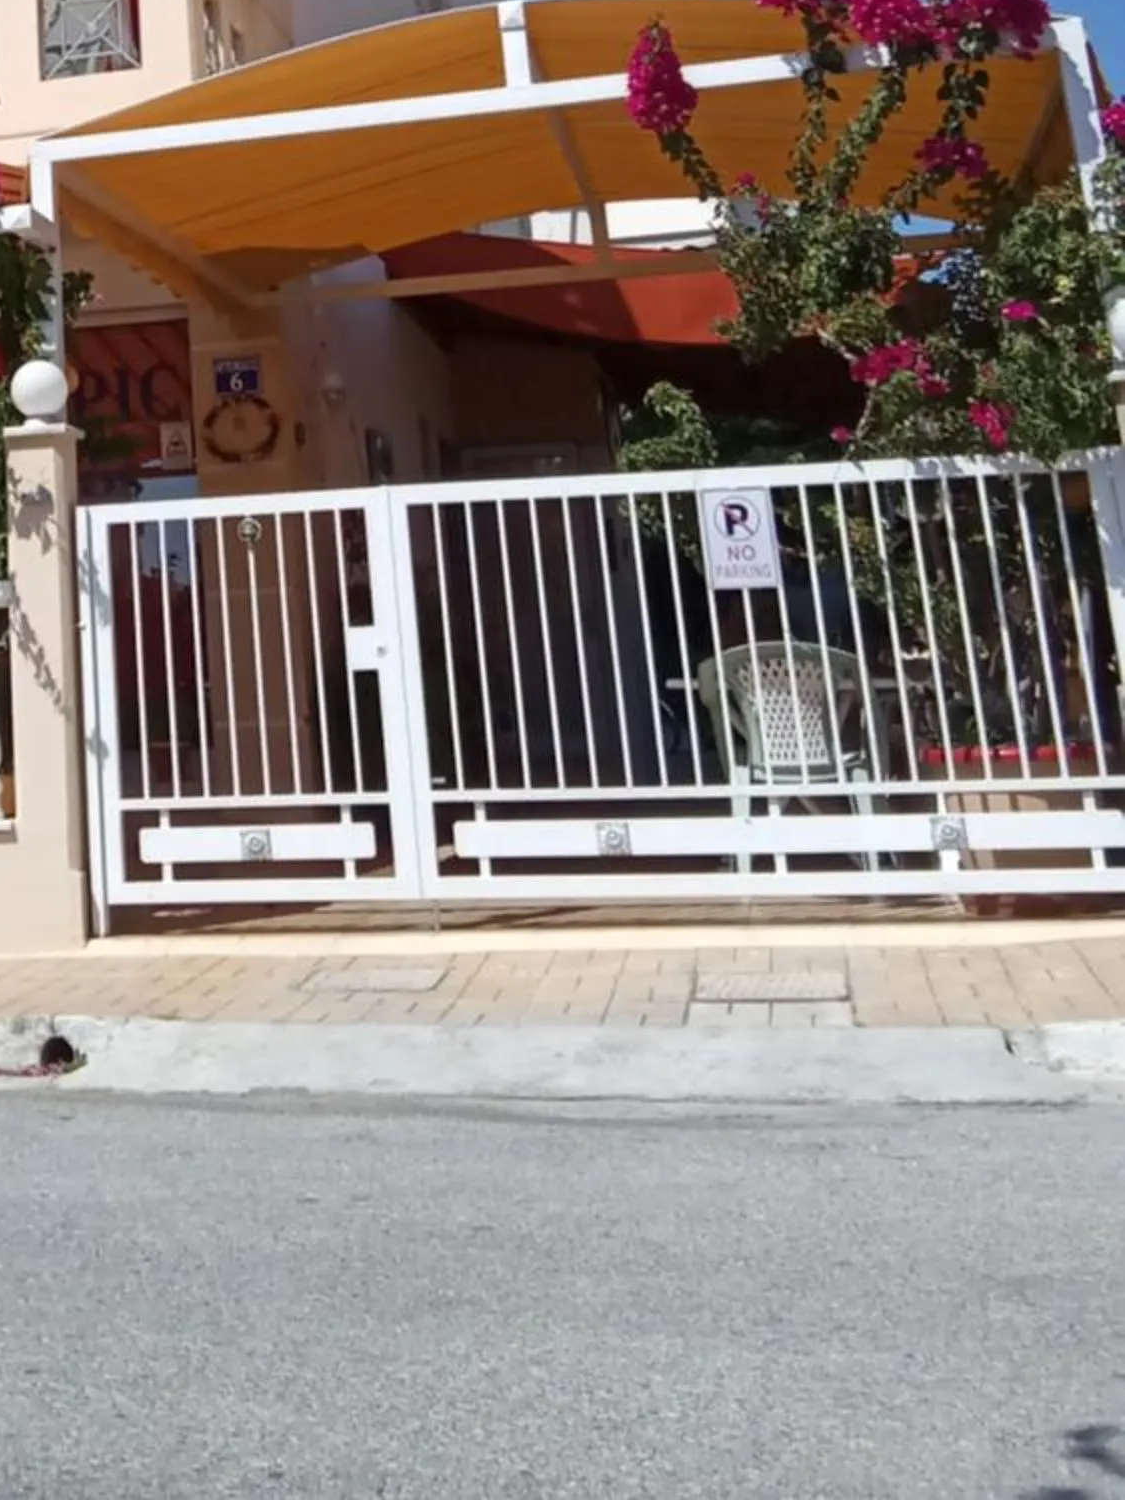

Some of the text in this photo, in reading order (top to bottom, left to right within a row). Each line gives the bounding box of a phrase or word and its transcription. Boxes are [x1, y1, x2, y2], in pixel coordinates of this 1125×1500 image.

[229, 371, 244, 392] 6
[722, 503, 749, 536] P
[727, 544, 756, 562] NO
[715, 564, 772, 579] PARKING
